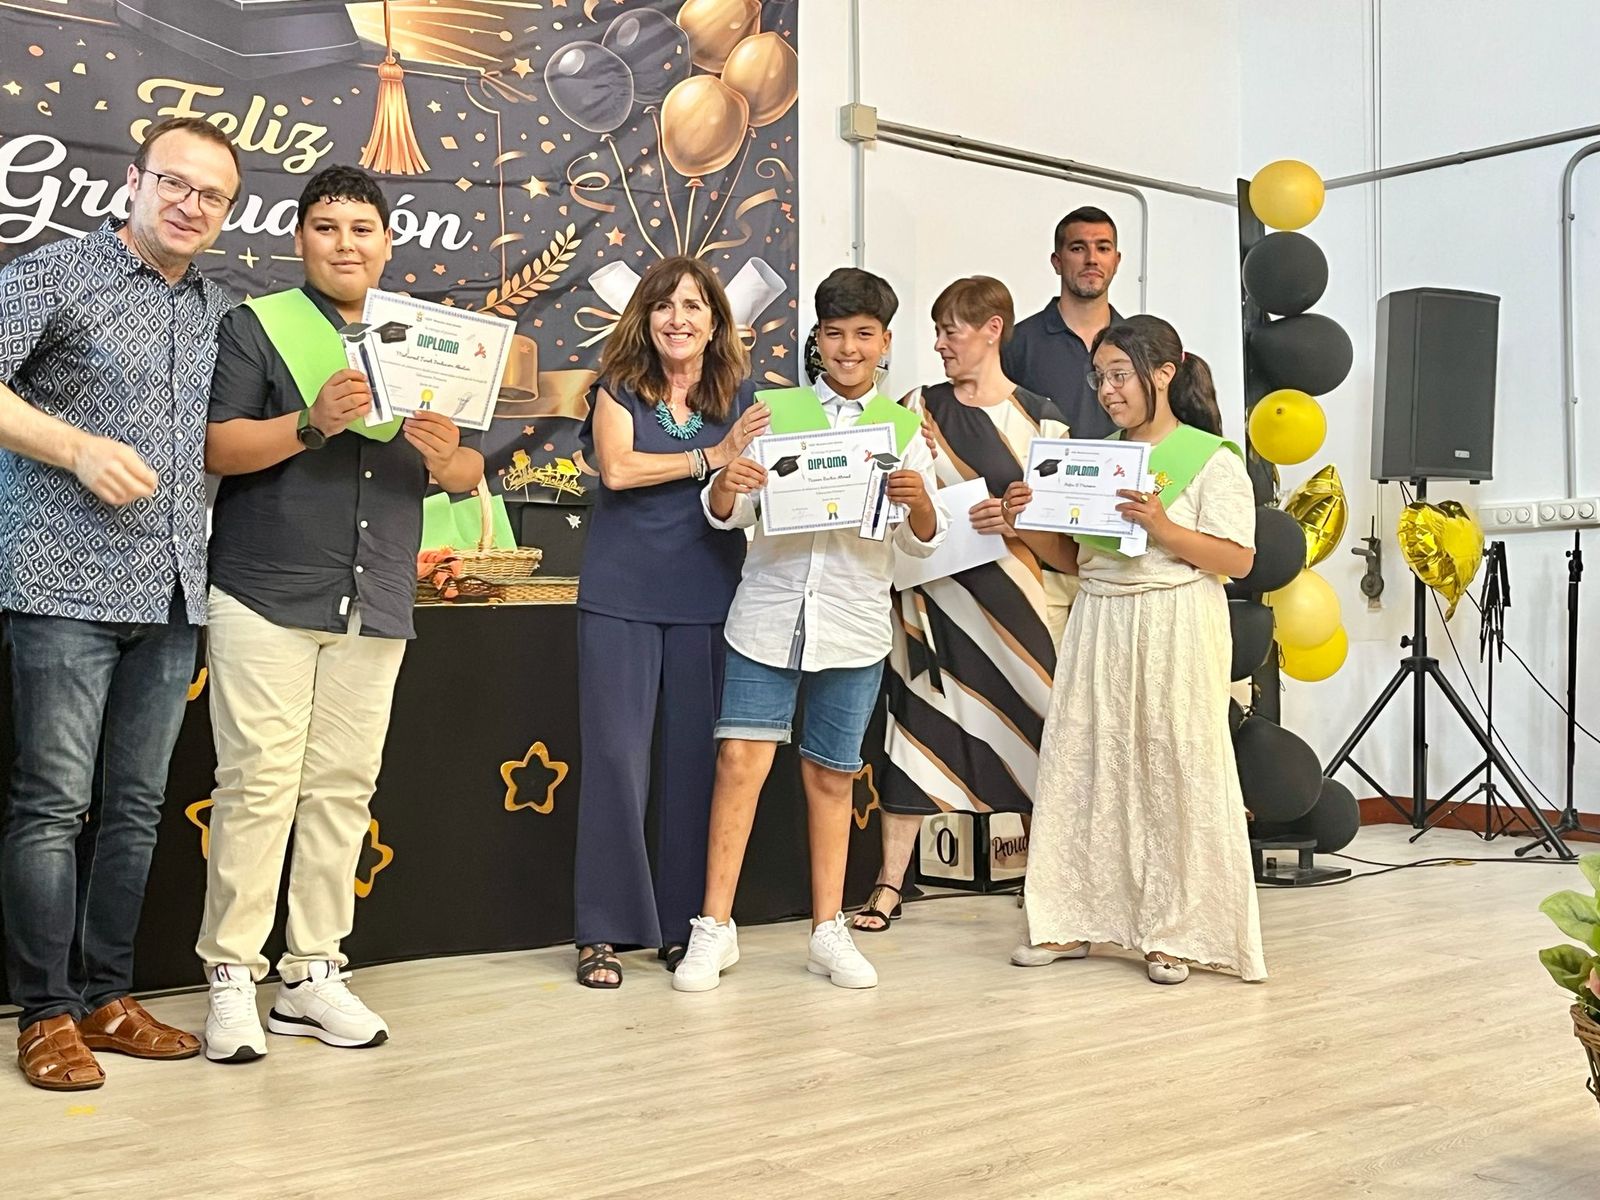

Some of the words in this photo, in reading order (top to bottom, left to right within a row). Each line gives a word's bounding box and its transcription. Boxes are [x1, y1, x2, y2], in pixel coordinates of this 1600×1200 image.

[130, 78, 334, 174] Feliz
[0, 134, 472, 250] Gruaón
[417, 333, 460, 355] DIPLOMA
[807, 455, 848, 471] DIPLOMA
[1065, 464, 1100, 477] DIPLOMA
